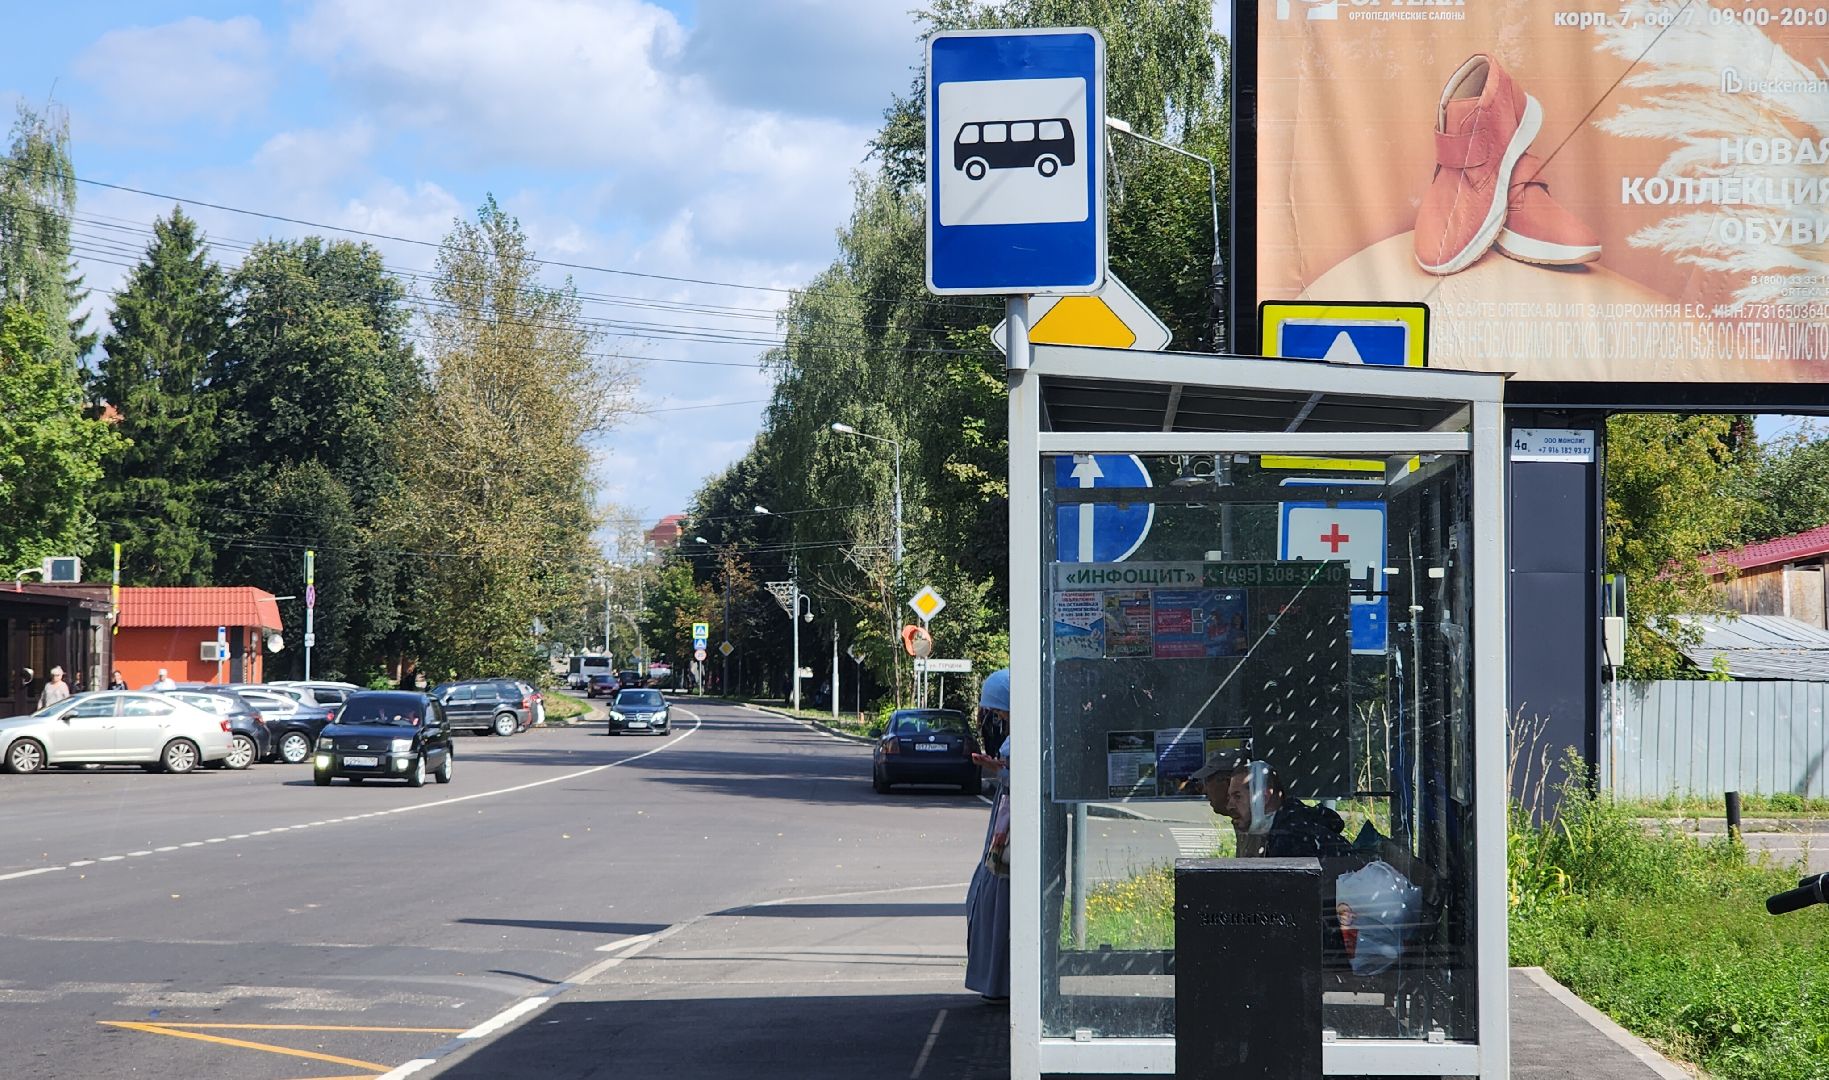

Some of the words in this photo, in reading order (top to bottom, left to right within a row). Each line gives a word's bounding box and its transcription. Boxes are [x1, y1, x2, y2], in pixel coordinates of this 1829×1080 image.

[1349, 12, 1427, 21] ОРТОПЕДИЧЕСКИЕ
[1429, 12, 1465, 21] САЛОНЫ
[1554, 10, 1612, 30] корп.
[1751, 275, 1758, 285] 8
[1458, 300, 1494, 318] САЙТЕ
[1499, 302, 1562, 318] ORTEKA.RU
[1565, 303, 1583, 318] ИП
[1588, 303, 1680, 320] ЗАДОРОЖНЯЯ
[1469, 321, 1551, 360] НЕОБХОДИМО
[1556, 321, 1714, 361] ПРОКОНСУЛЬТИРОВАТЬСЯ
[1717, 322, 1734, 361] СО
[1066, 568, 1196, 586] «ИНФОЩИТ»
[1222, 565, 1261, 584] (495)
